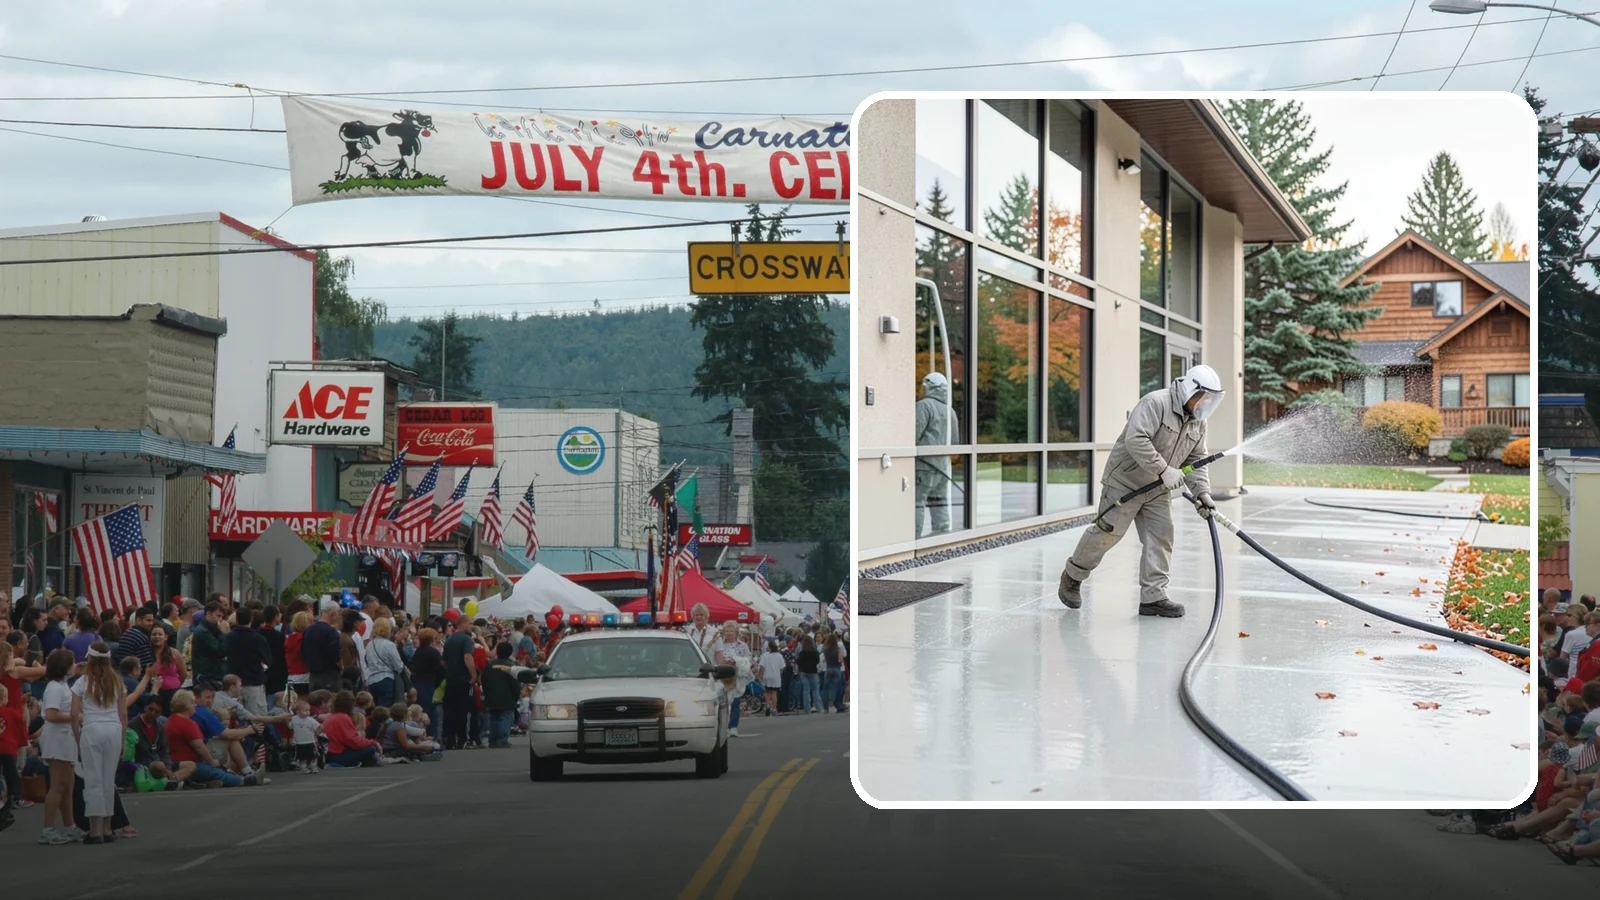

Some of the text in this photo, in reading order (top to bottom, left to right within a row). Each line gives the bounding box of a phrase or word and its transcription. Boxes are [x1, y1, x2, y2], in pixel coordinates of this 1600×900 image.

[695, 121, 850, 149] Carnat
[481, 141, 604, 193] JULY
[632, 150, 746, 198] 4th.
[697, 254, 850, 280] CROSSWA
[283, 380, 373, 420] ACE
[405, 409, 485, 422] CEDAR LOG
[284, 421, 371, 436] Hardware
[83, 485, 155, 495] St. Vincent de Paul
[699, 535, 730, 543] GLASS
